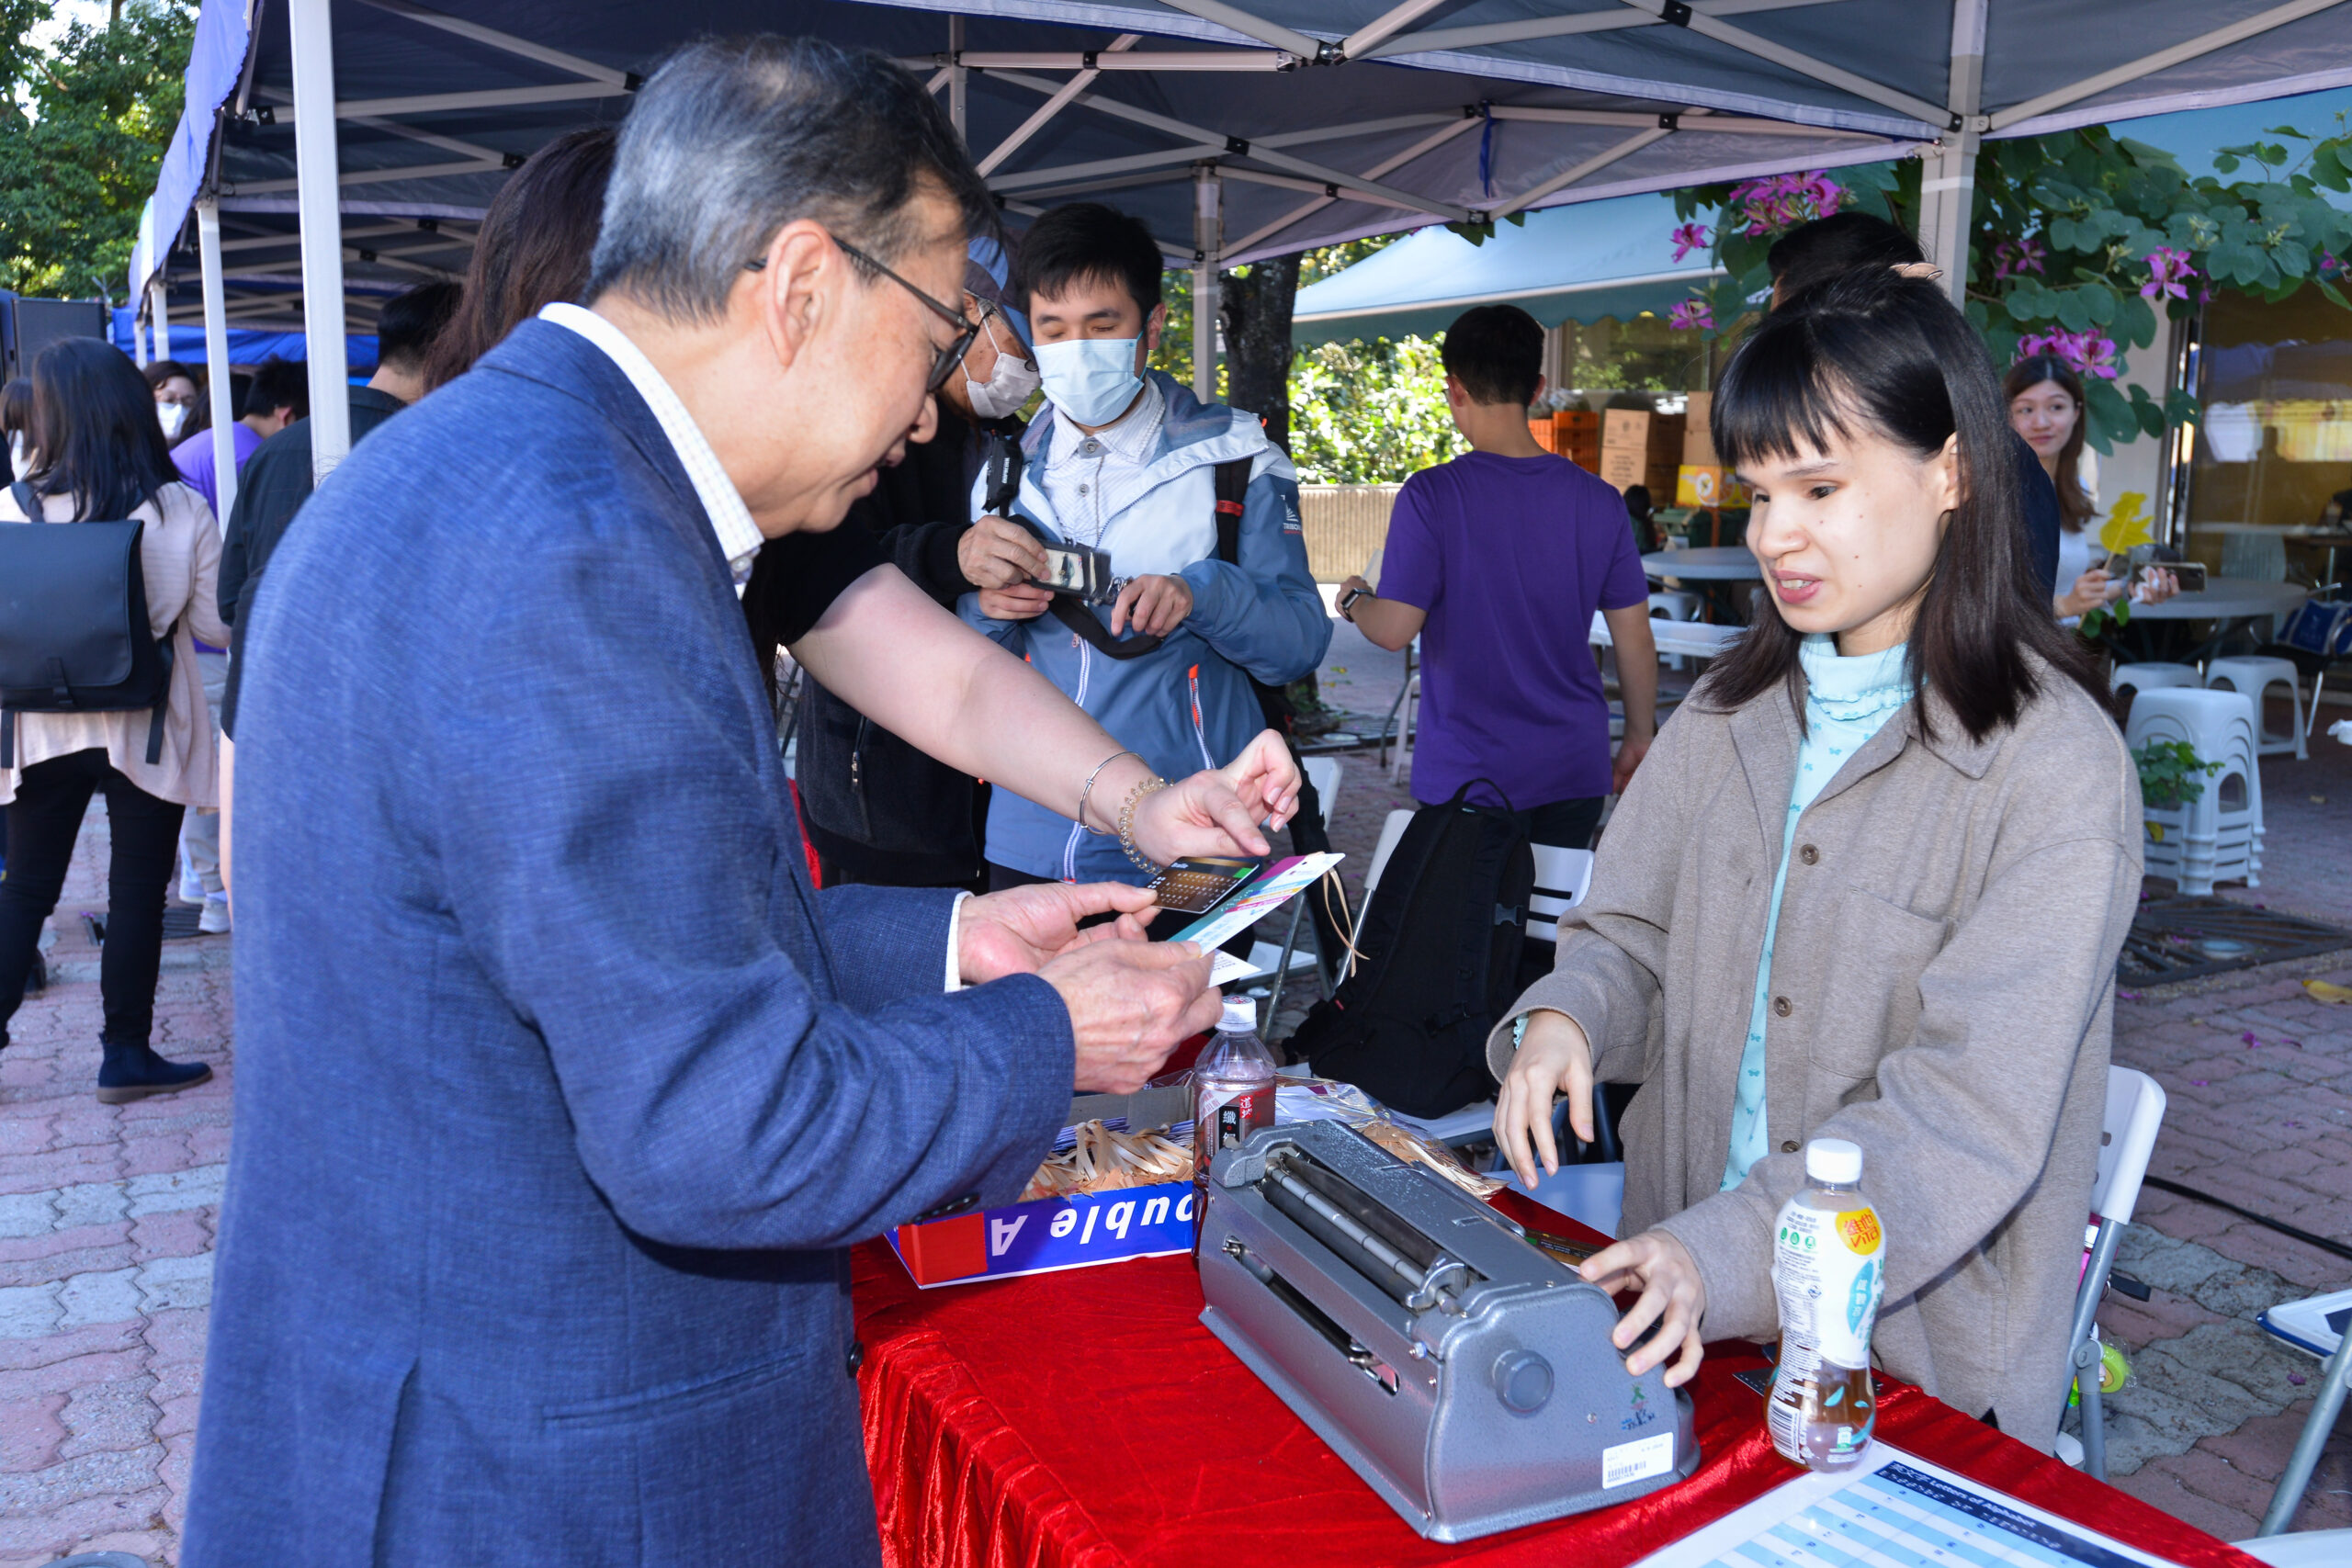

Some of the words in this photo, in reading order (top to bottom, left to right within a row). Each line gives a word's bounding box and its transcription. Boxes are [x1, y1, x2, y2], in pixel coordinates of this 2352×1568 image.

[990, 1215, 1029, 1257] A
[1928, 1479, 1968, 1500] Letters
[1969, 1495, 1984, 1506] of
[1981, 1501, 2038, 1529] Alphabet
